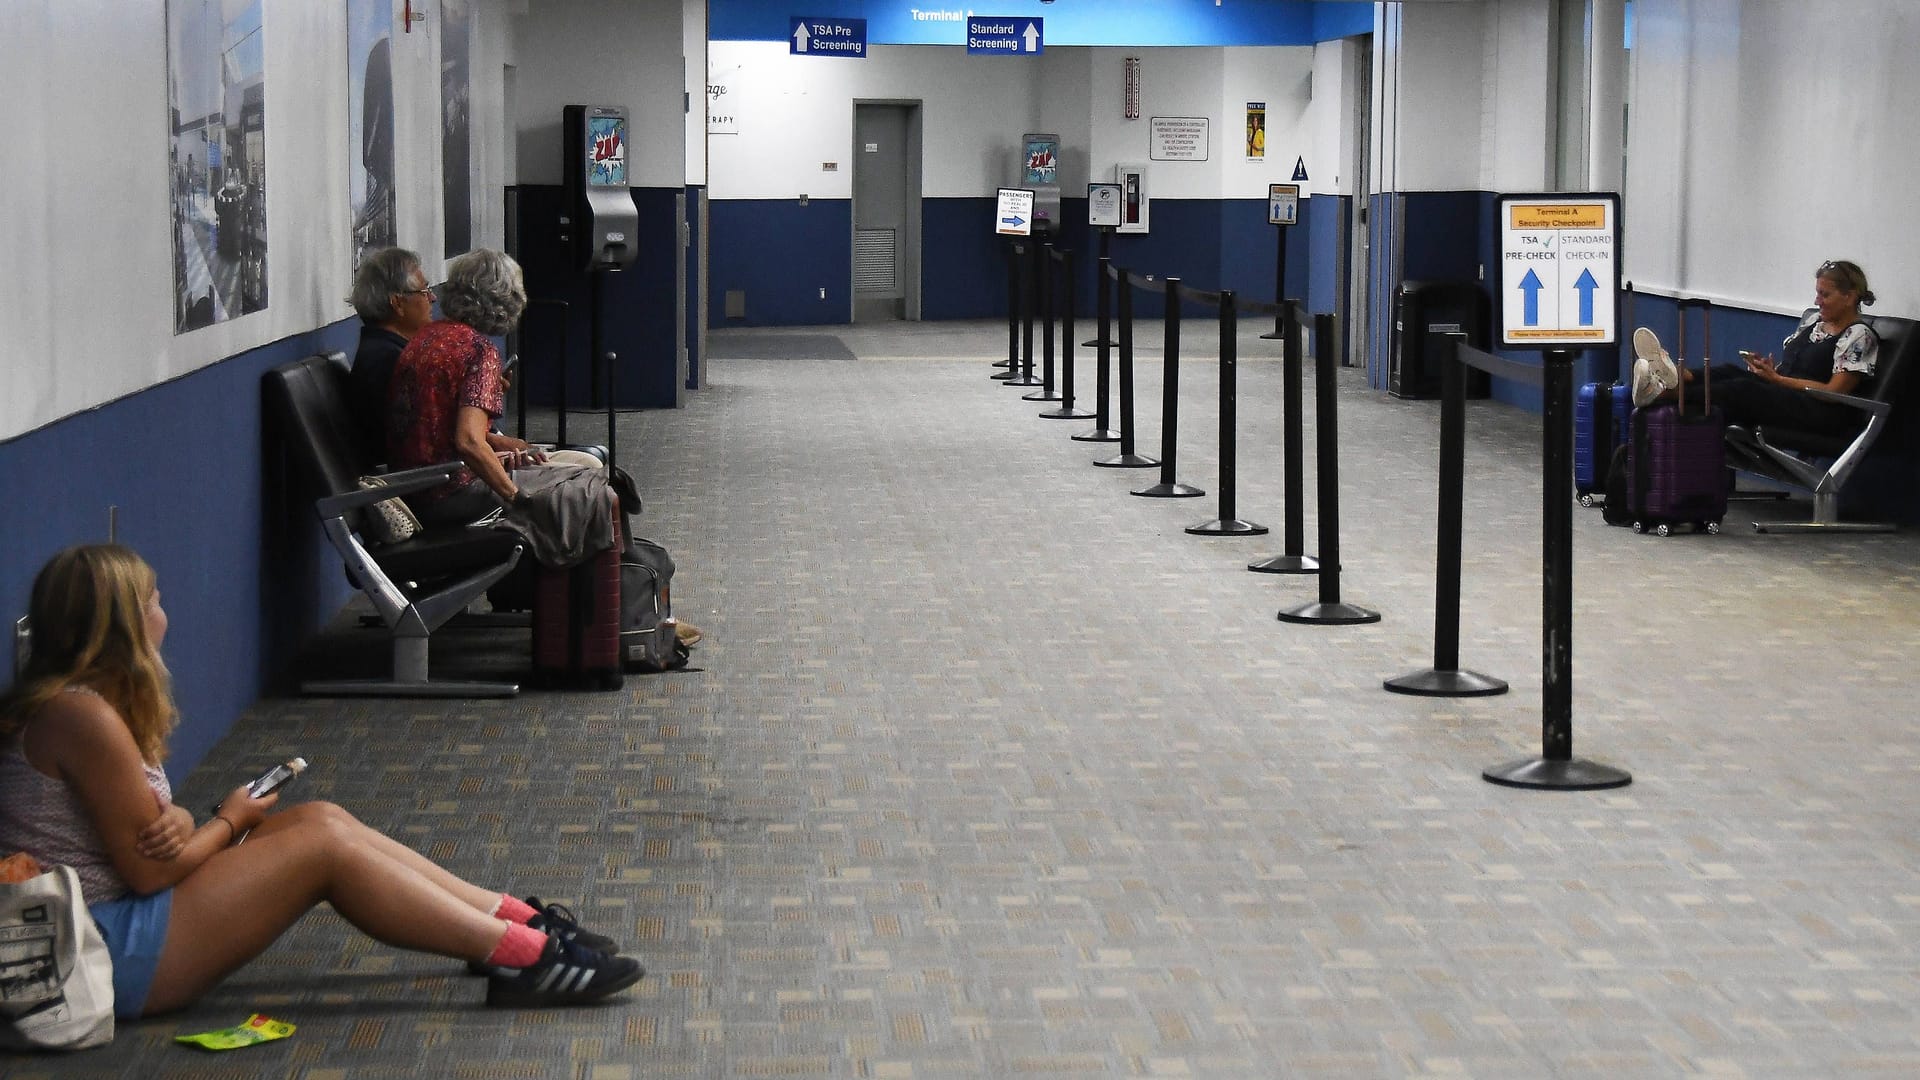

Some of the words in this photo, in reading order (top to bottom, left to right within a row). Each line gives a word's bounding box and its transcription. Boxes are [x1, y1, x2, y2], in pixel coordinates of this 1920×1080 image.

[911, 9, 963, 21] Terminal
[812, 24, 833, 36] TSA
[835, 25, 852, 36] Pre
[971, 23, 1014, 34] Standard
[813, 39, 862, 53] Screening
[969, 37, 1018, 51] Screening
[595, 134, 620, 161] ZAP
[1000, 191, 1033, 199] PASSENGERS
[1518, 220, 1550, 228] Security
[1552, 220, 1596, 228] Checkpoint
[1521, 236, 1538, 244] TSA
[1561, 236, 1612, 244] STANDARD
[1505, 252, 1556, 260] PRE-CHECK
[1565, 252, 1609, 260] CHECK-IN
